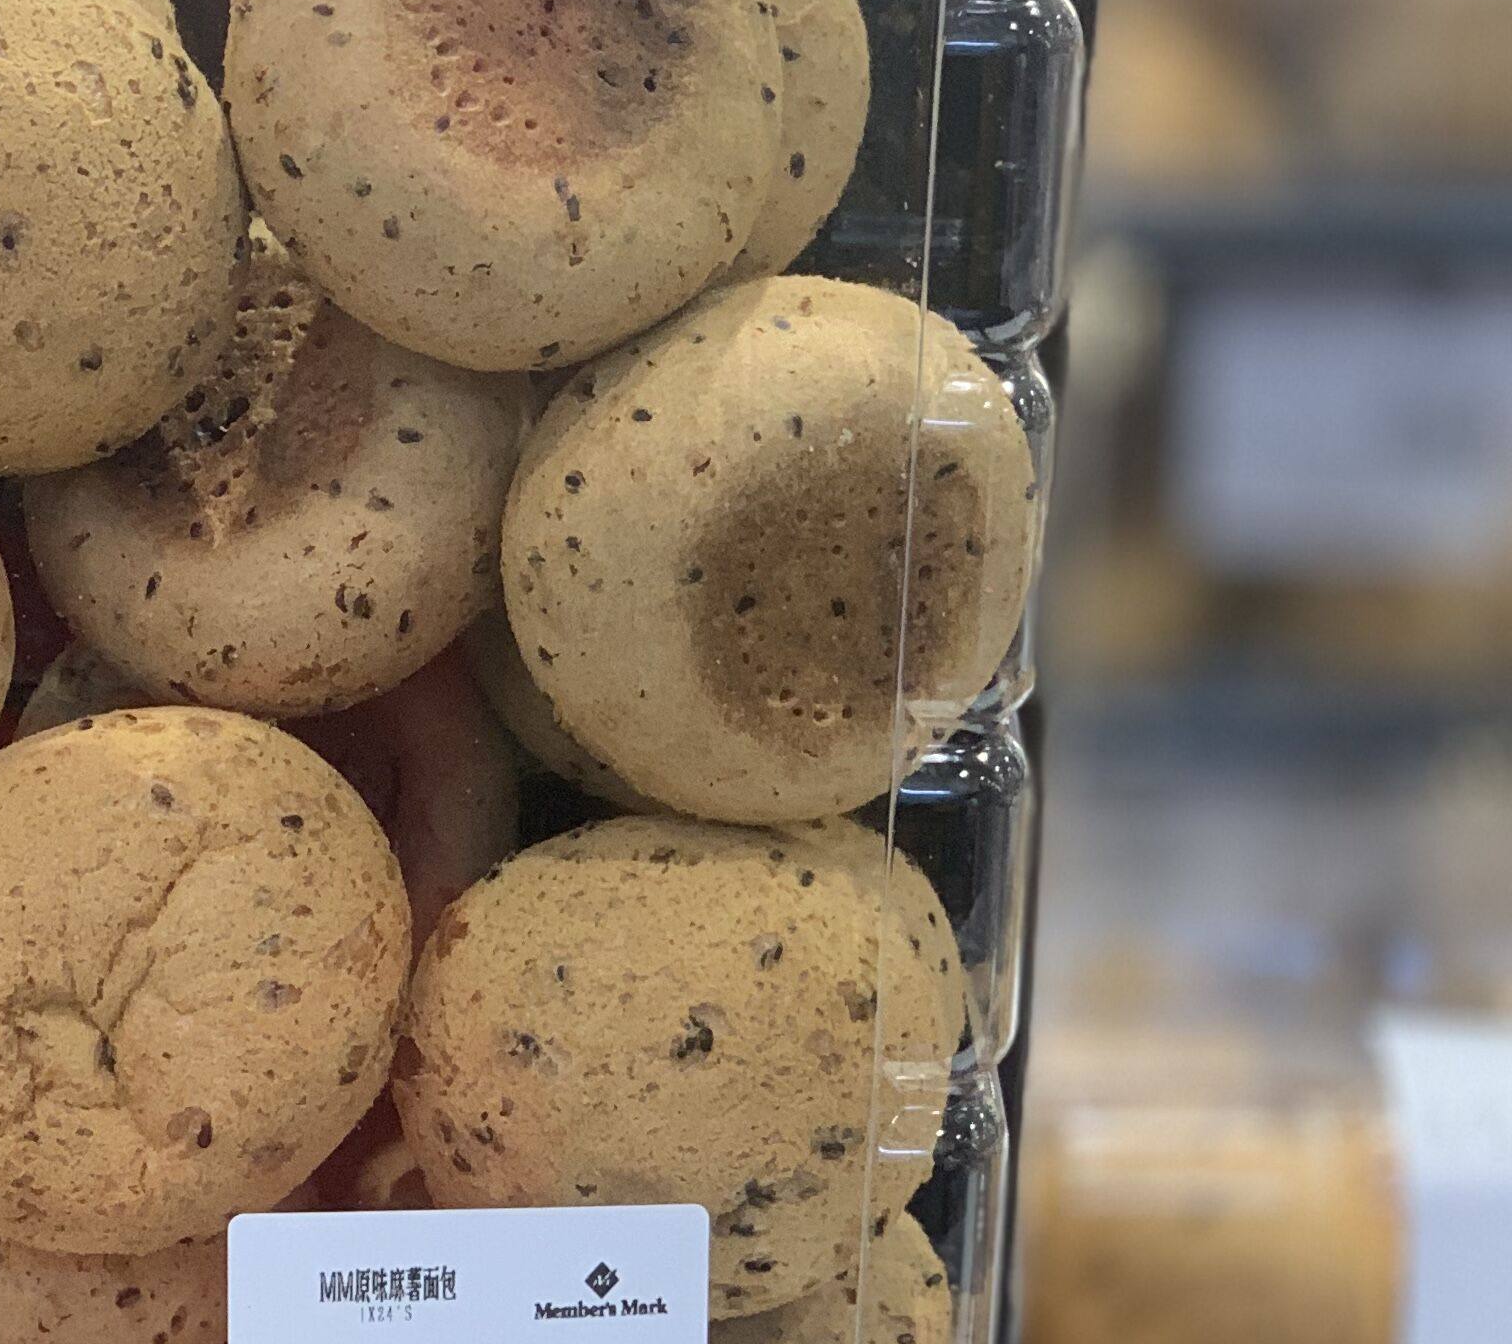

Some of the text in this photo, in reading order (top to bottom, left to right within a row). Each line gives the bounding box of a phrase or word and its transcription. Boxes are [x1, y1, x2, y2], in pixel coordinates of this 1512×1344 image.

[319, 1265, 458, 1303] MM原味麻薯面包
[534, 1297, 668, 1320] Member's Mark
